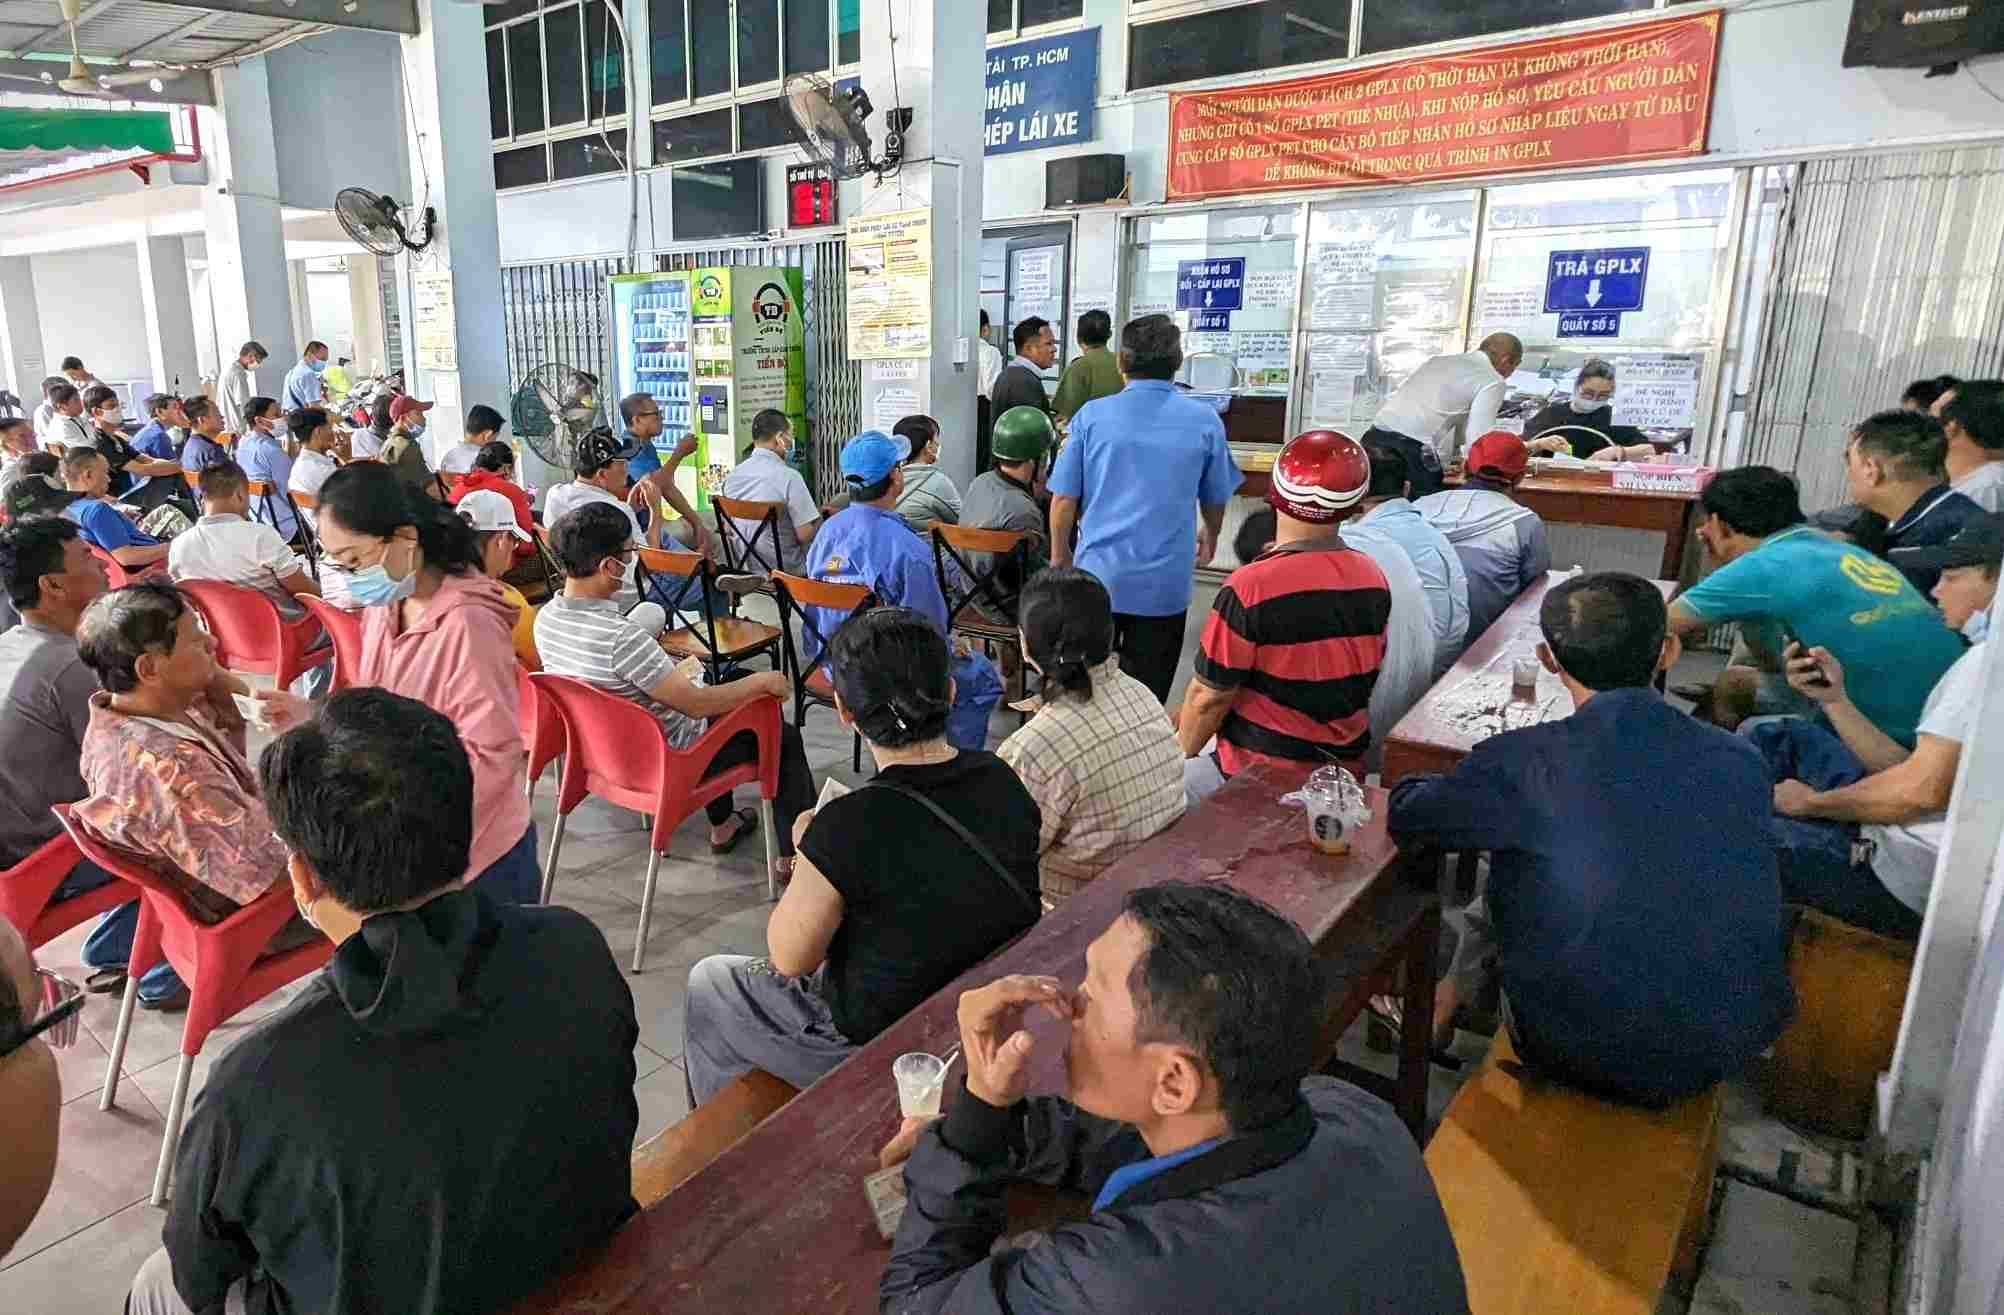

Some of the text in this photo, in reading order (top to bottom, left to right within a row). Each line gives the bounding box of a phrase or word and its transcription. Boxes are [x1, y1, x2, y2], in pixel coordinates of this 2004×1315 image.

[1012, 55, 1033, 70] TP.
[1036, 47, 1069, 67] HCM
[1321, 84, 1353, 104] TÁCH
[1356, 84, 1364, 98] 2
[1366, 78, 1400, 97] GPLX
[1430, 65, 1463, 89] THỜI
[1466, 64, 1497, 87] HẠN
[1503, 57, 1518, 79] VÀ
[1524, 51, 1579, 76] KHÔNG
[1583, 42, 1623, 66] THỜI
[984, 80, 1026, 112] HẬN
[1264, 113, 1281, 134] SỐ
[1282, 116, 1313, 133] GPLX
[1316, 112, 1340, 129] PET
[1422, 98, 1447, 117] KHI
[1450, 91, 1479, 116] NỘP
[1483, 84, 1504, 109] HỒ
[1535, 79, 1564, 102] YÊU
[1568, 69, 1602, 97] CẦU
[1605, 65, 1656, 93] NGƯỜI
[1663, 62, 1698, 86] DÂN
[1019, 110, 1048, 142] LÁI
[1053, 112, 1078, 137] XE
[1205, 142, 1227, 162] CẤP
[1230, 140, 1245, 160] SỐ
[1246, 143, 1277, 159] GPLX
[1303, 138, 1328, 154] CHO
[1329, 132, 1356, 152] CÁN
[1359, 129, 1376, 151] BỘ
[1380, 123, 1409, 147] TIẾP
[1413, 122, 1451, 144] NHẬN
[1455, 115, 1474, 138] HỒ
[1478, 117, 1497, 136] SƠ
[1501, 110, 1542, 134] NHẬP
[1545, 105, 1583, 130] LIỆU
[1585, 101, 1630, 124] NGAY
[1633, 93, 1657, 118] TỪ
[1283, 160, 1325, 179] KHÔNG
[1367, 155, 1411, 174] TRONG
[1415, 147, 1442, 172] QUÁ
[1447, 143, 1489, 166] TRÌNH
[1494, 144, 1510, 161] IN
[1513, 139, 1552, 160] GPLX
[1555, 255, 1642, 276] TRẢ GPLX
[1223, 278, 1241, 289] GPLX
[1210, 315, 1221, 328] SỐ
[1591, 315, 1607, 331] SỐ
[1608, 319, 1616, 331] 5
